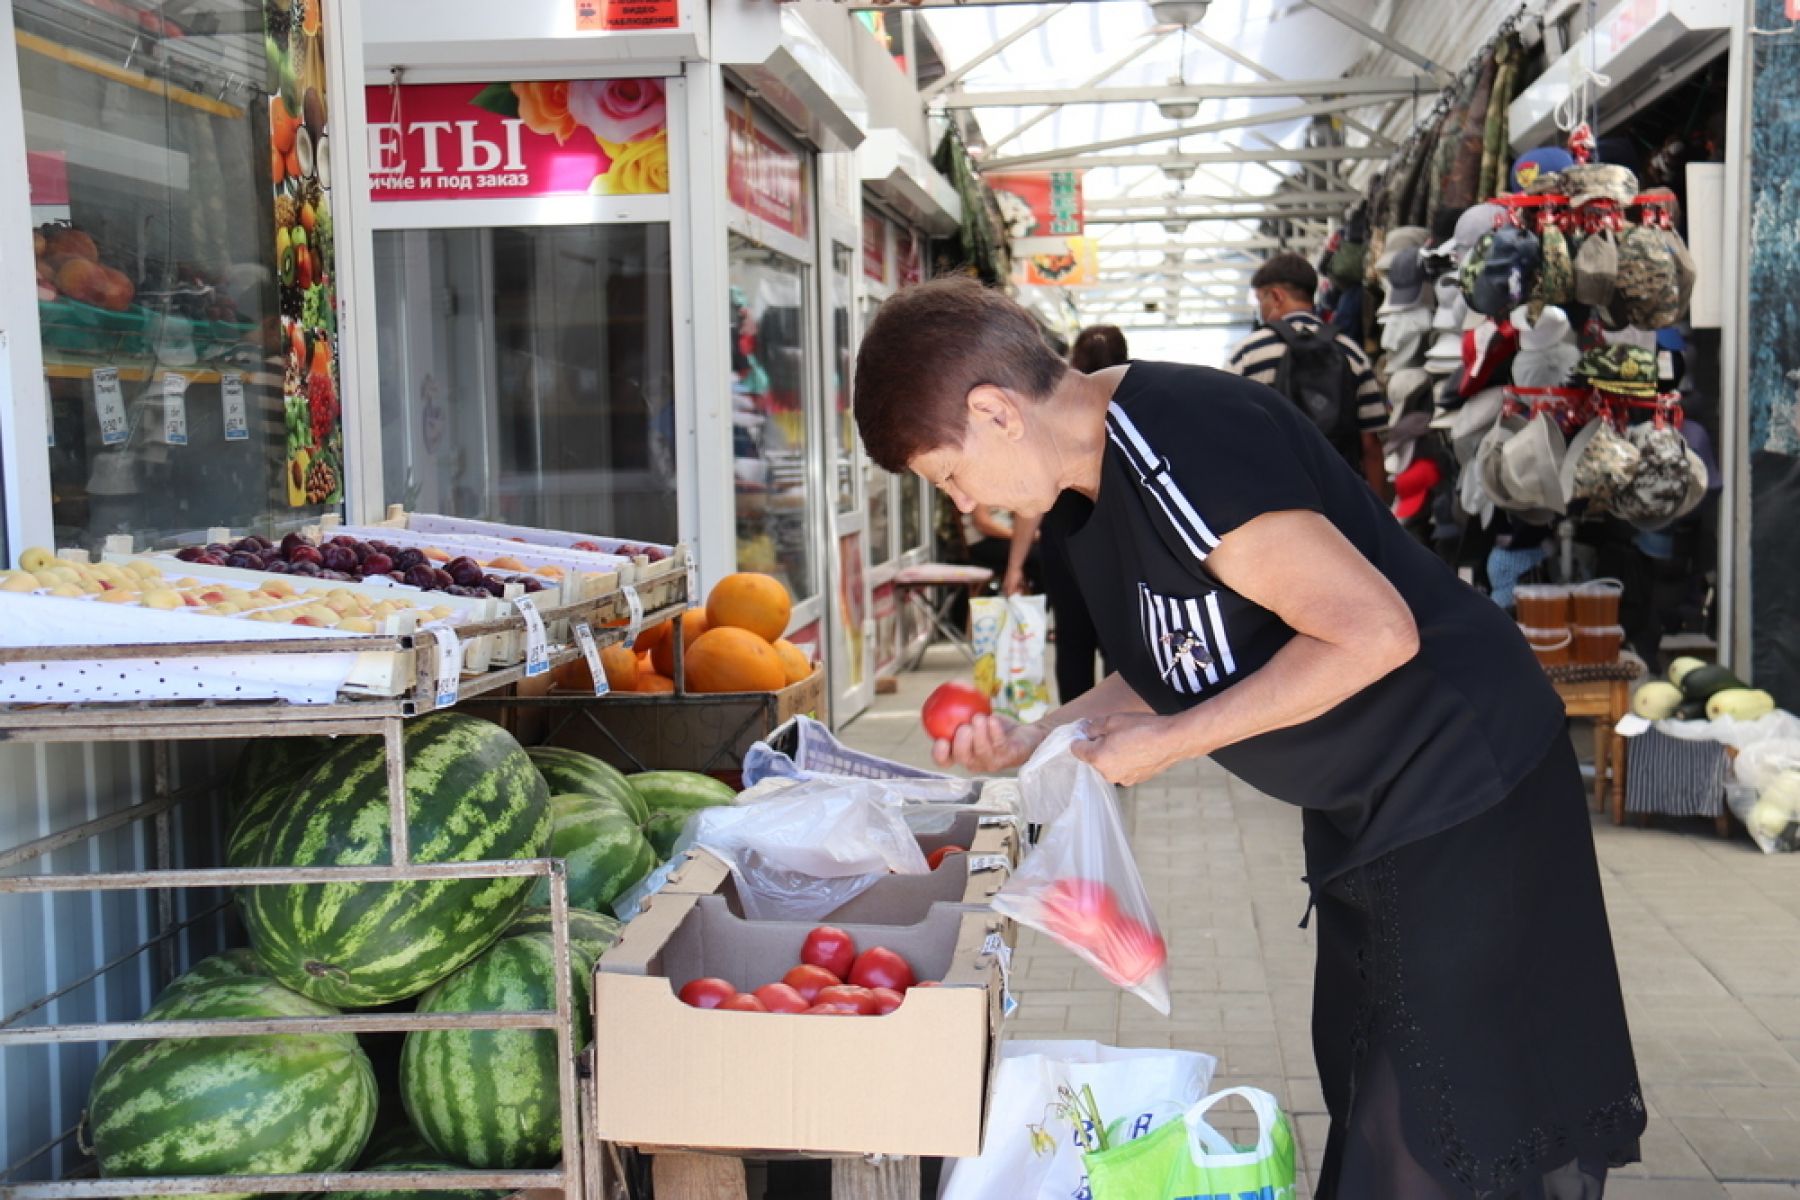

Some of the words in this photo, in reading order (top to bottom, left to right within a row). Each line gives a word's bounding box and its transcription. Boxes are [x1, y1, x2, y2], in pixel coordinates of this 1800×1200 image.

[420, 176, 433, 189] и
[437, 175, 473, 190] под
[476, 174, 529, 187] заказ
